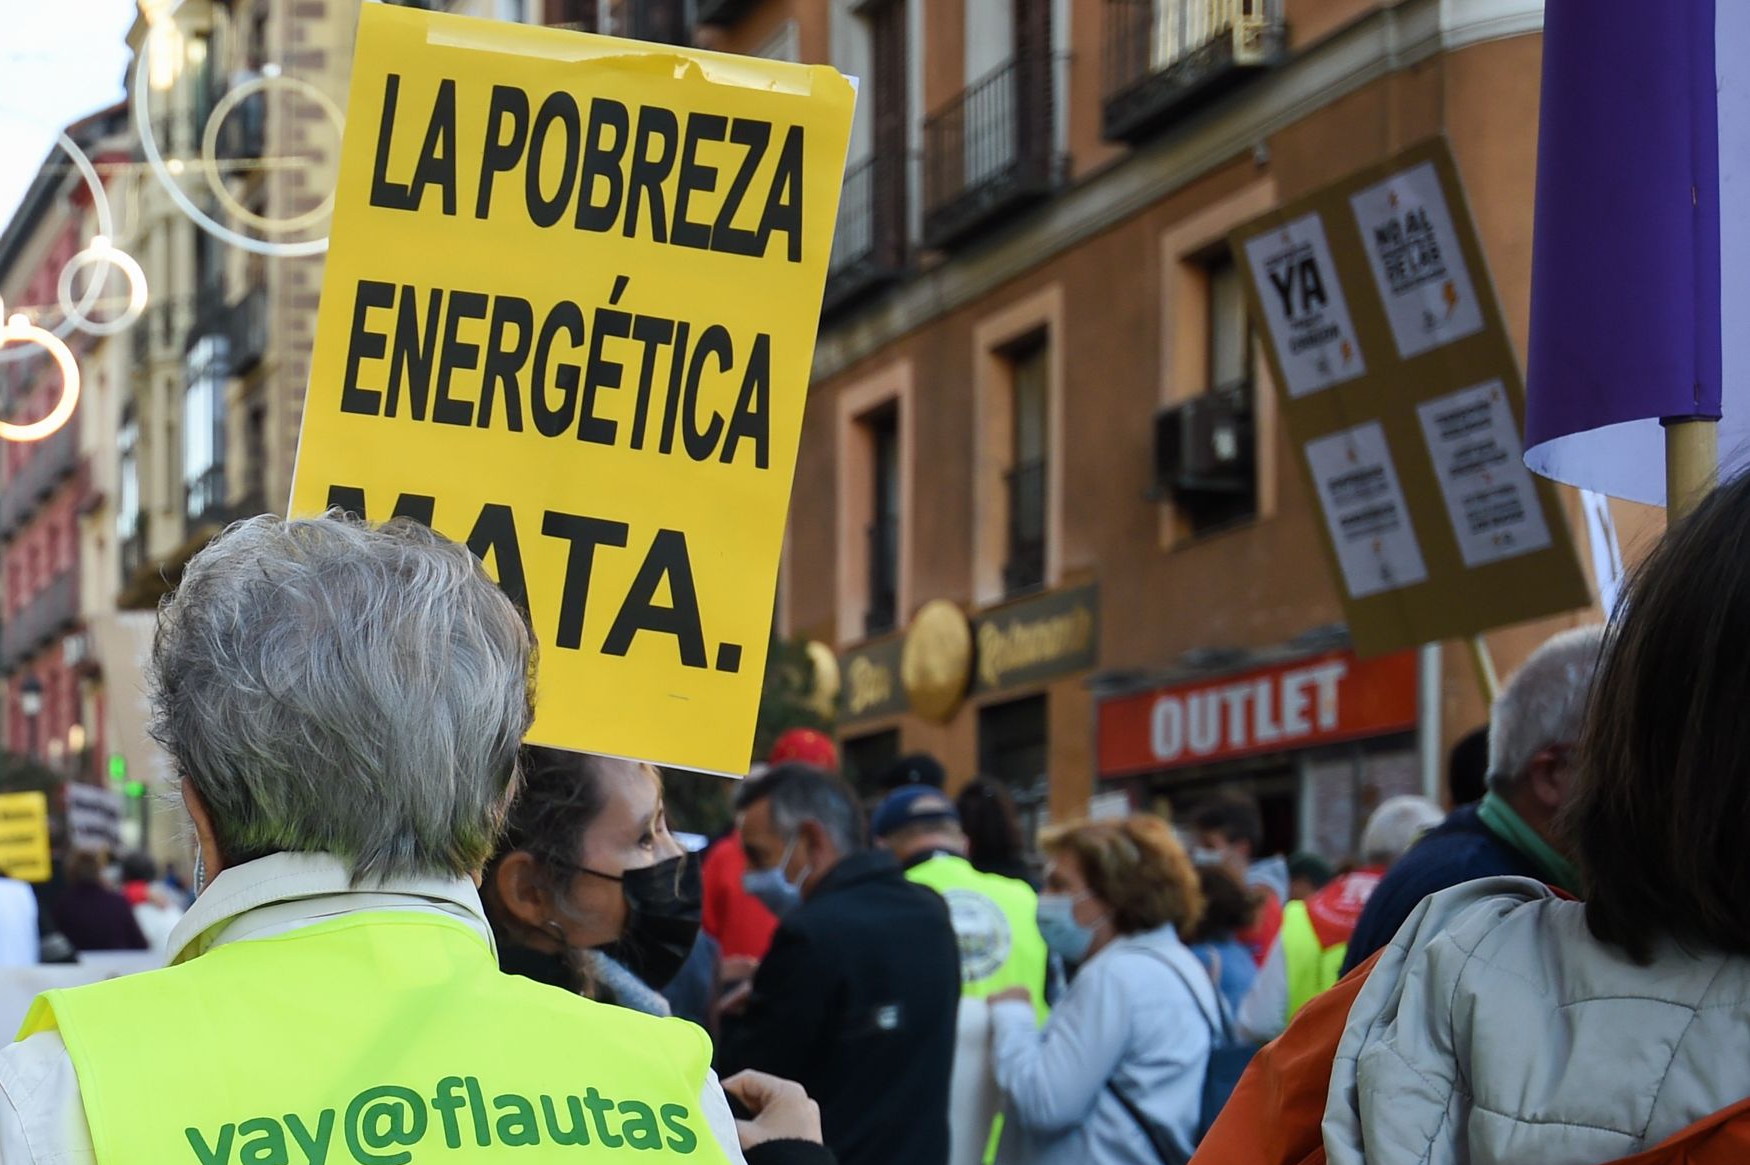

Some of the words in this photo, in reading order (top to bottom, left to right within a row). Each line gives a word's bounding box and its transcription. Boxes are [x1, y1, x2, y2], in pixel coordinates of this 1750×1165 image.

[369, 73, 457, 216] LA
[475, 84, 804, 263] POBREZA
[340, 275, 771, 470] ENERGÉTICA
[1269, 256, 1327, 318] YA
[325, 484, 742, 674] ATA.
[1151, 659, 1347, 762] OUTLET
